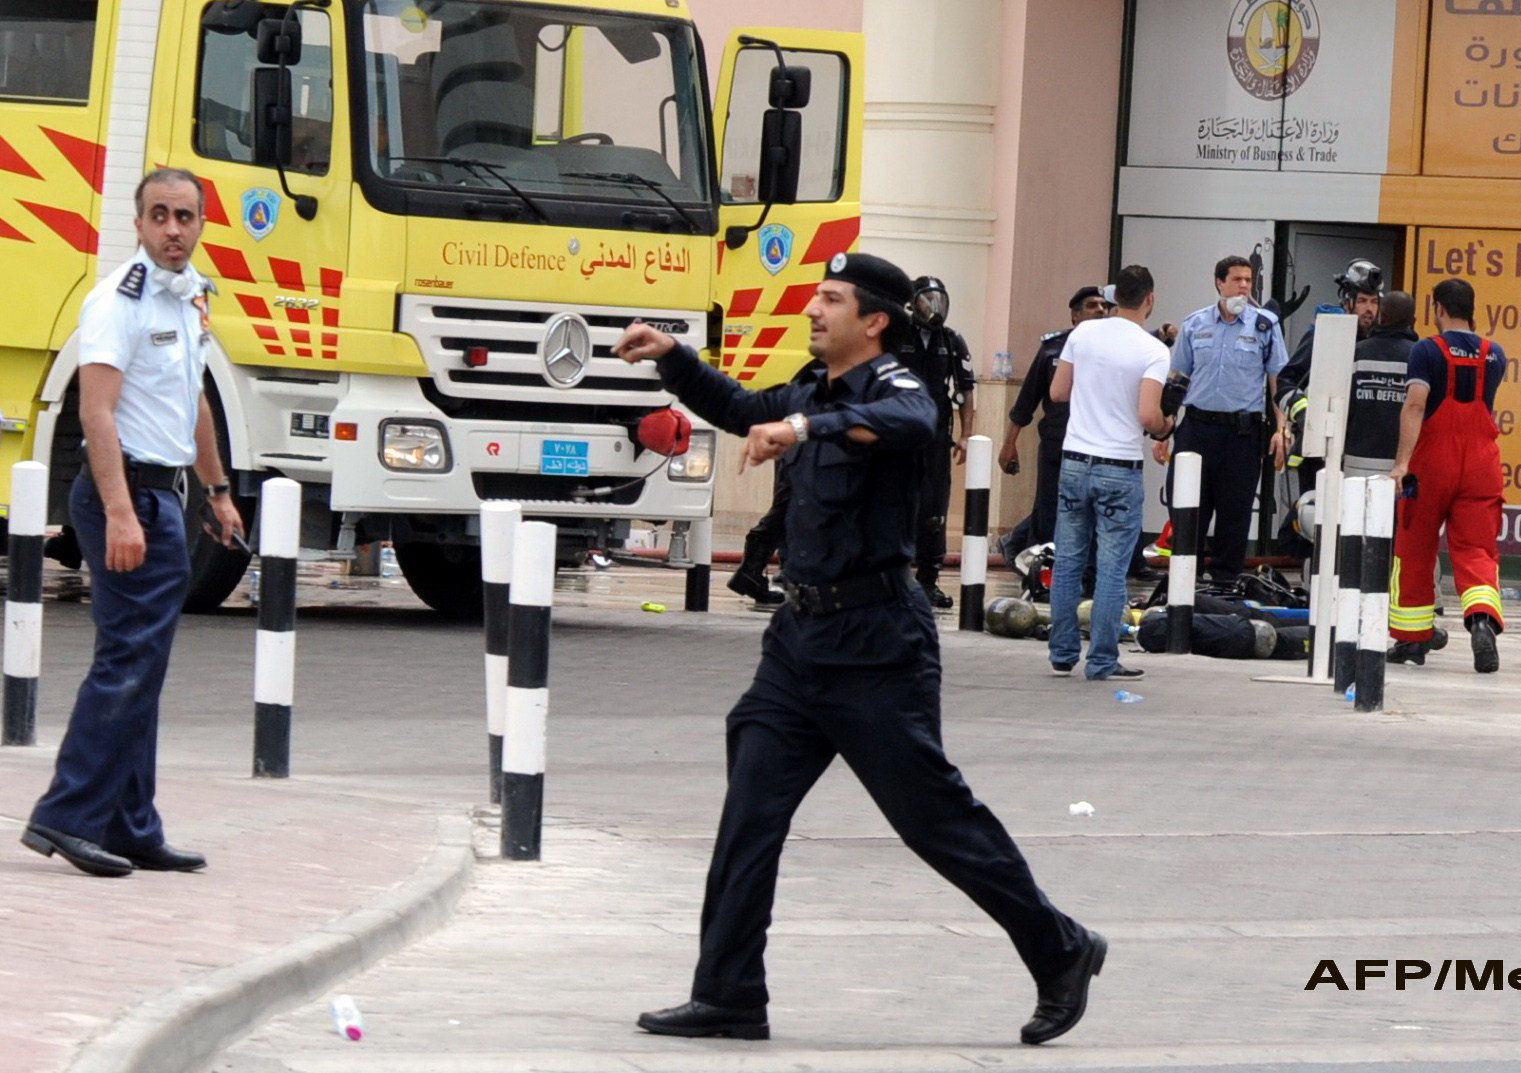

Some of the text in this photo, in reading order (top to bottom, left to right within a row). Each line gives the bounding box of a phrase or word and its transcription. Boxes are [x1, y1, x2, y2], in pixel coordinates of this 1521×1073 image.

[1196, 144, 1236, 164] Ministry
[1240, 146, 1250, 160] of
[1296, 147, 1305, 161] &
[1309, 147, 1337, 162] Trade
[442, 242, 566, 270] Civil Defence
[580, 242, 690, 284] الدفاع المدني
[415, 276, 454, 289] rosenbauer
[273, 295, 319, 310] 2632
[1356, 389, 1407, 402] CIVIL DEFENC
